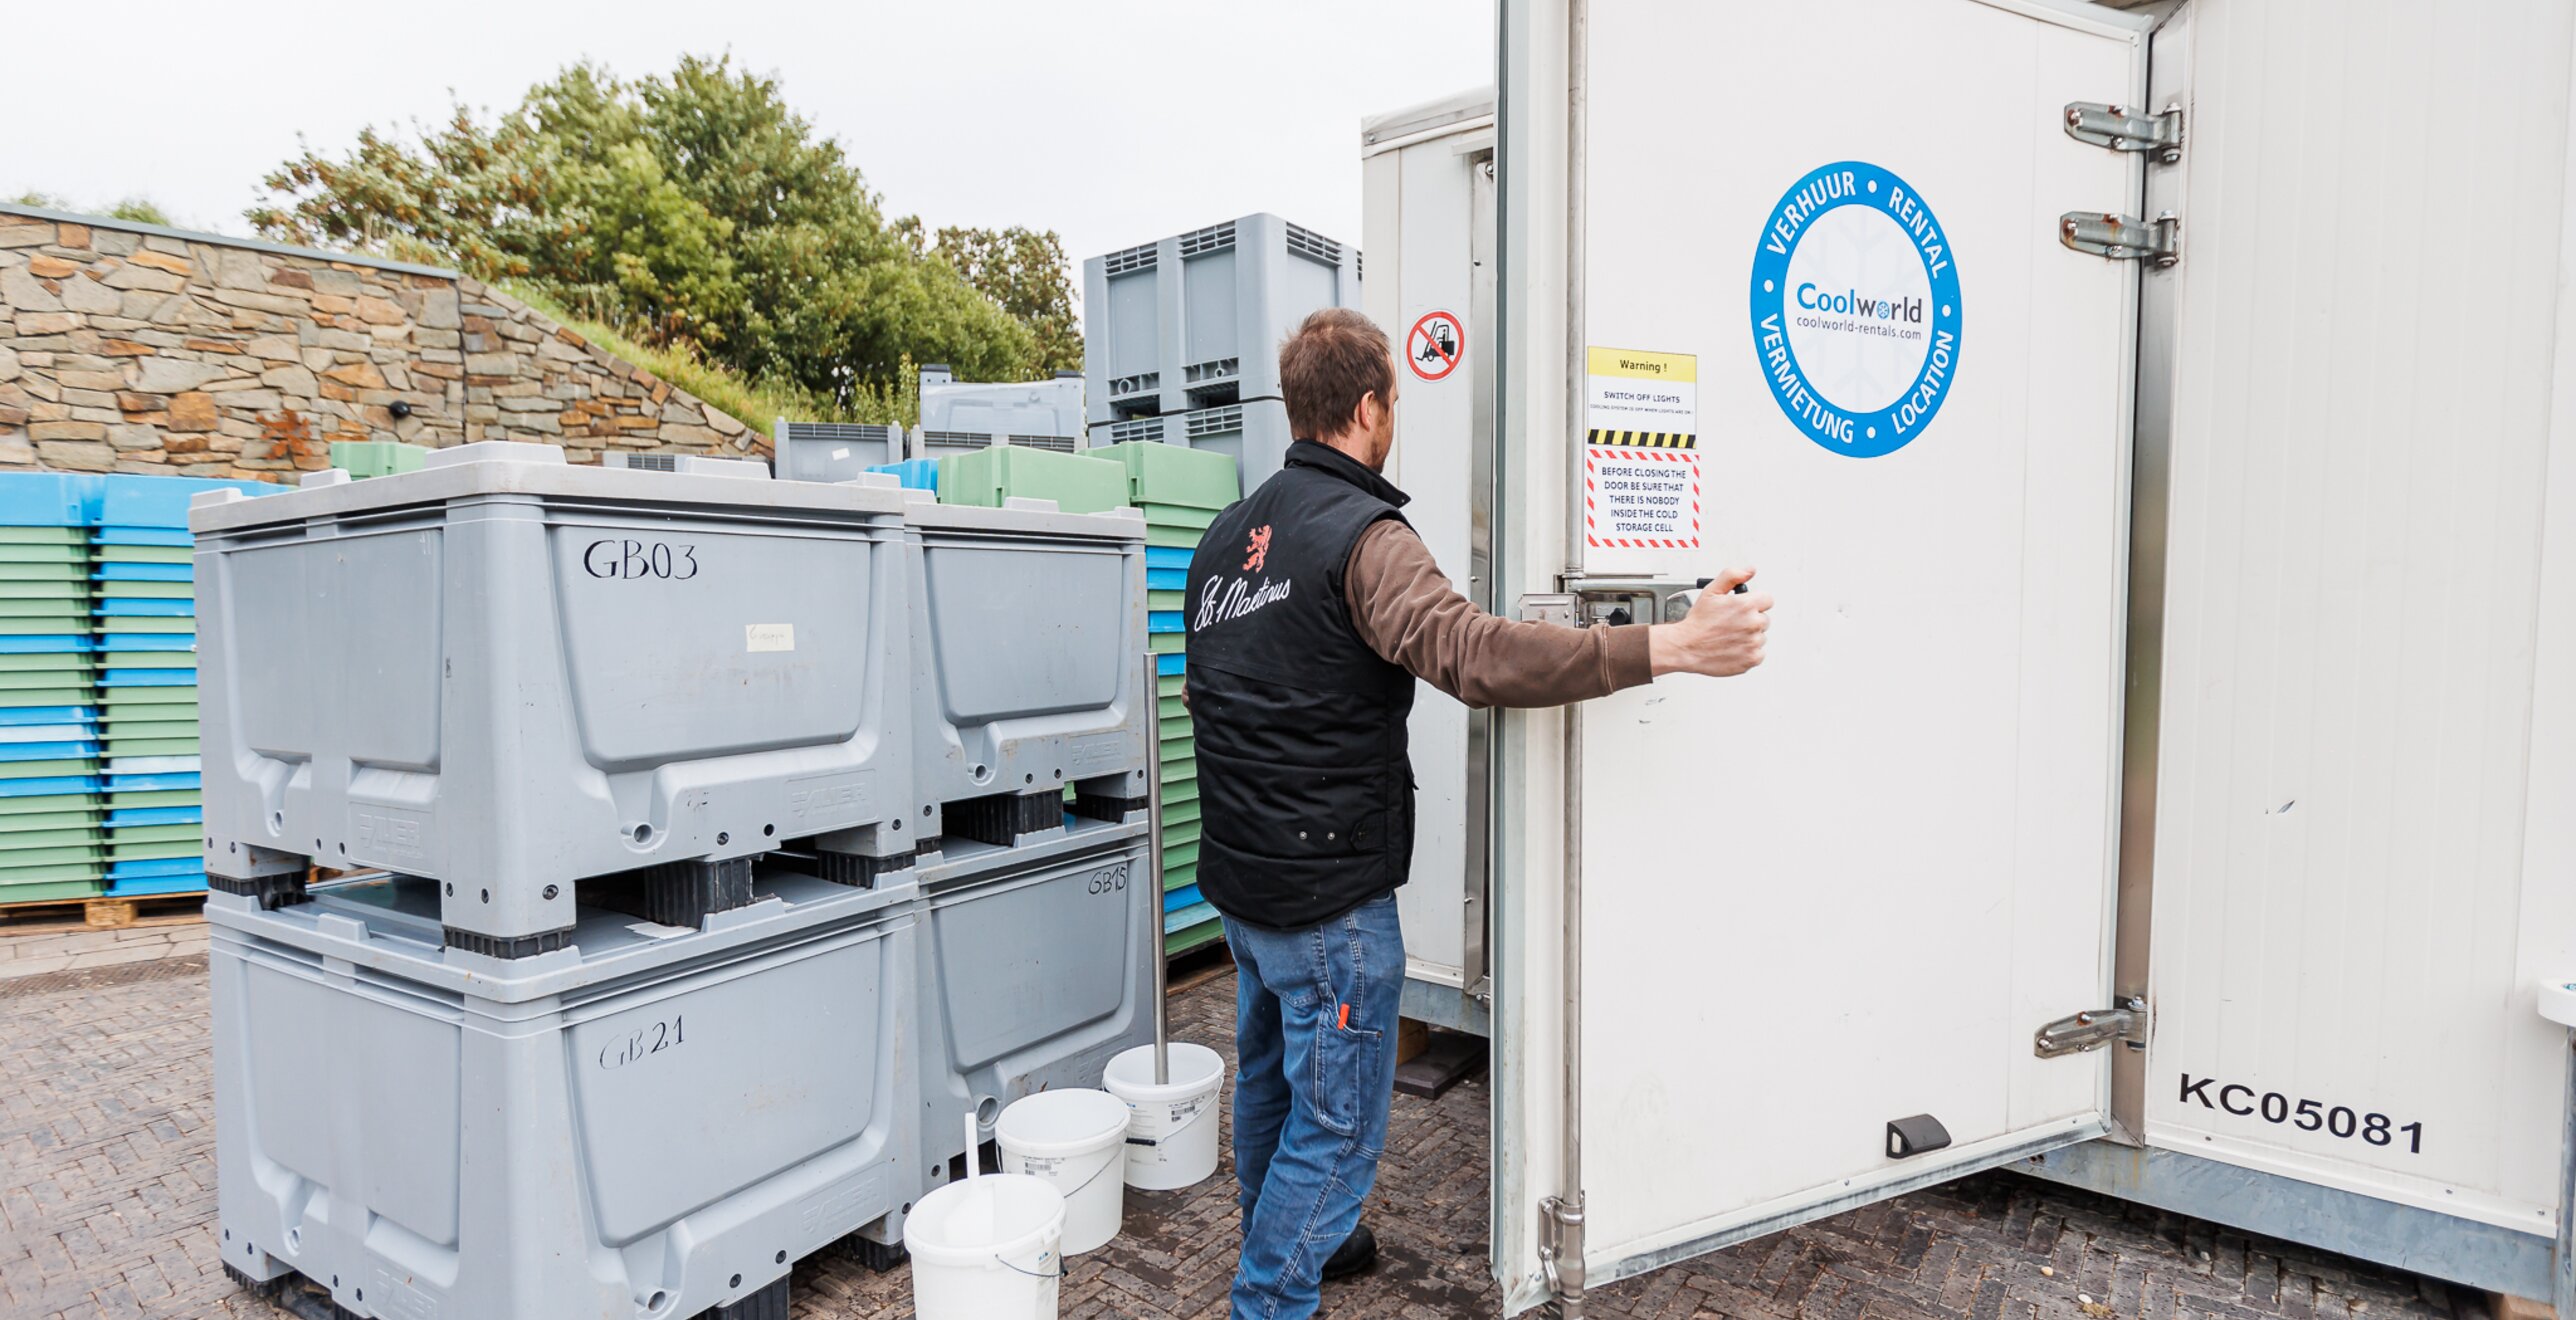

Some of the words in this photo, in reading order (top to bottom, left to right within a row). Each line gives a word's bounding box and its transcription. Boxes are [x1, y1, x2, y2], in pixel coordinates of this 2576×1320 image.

[1766, 171, 1856, 255] VERHUUR
[1888, 186, 1948, 279] RENTAL
[1797, 282, 1922, 323] Coolworld
[1796, 316, 1922, 340] coolworld-rentals.com
[1619, 359, 1661, 374] Warning
[1760, 313, 1854, 444] VERMIETUNG
[1891, 330, 1954, 435] LOCATION
[1604, 391, 1635, 401] SWITCH
[1636, 394, 1651, 402] OFF
[1653, 395, 1680, 404] LIGHTS
[1602, 466, 1633, 477] BEFORE
[1635, 468, 1670, 478] CLOSING
[1672, 470, 1686, 479] THE
[1605, 481, 1629, 490] DOOR
[1631, 482, 1640, 490] BE
[1642, 482, 1662, 491] SURE
[1664, 483, 1684, 492] THAT
[1609, 495, 1635, 504] THERE
[1637, 496, 1644, 504] IS
[1646, 496, 1680, 505] NOBODY
[1611, 509, 1637, 518] INSIDE
[1639, 510, 1654, 518] THE
[1656, 510, 1678, 519] COLD
[1616, 523, 1653, 532] STORAGE
[1655, 523, 1673, 532] CELL
[583, 539, 698, 580] GB03
[1216, 577, 1291, 623] Martinus
[1088, 866, 1126, 895] GB15
[2179, 1073, 2422, 1154] KC05081
